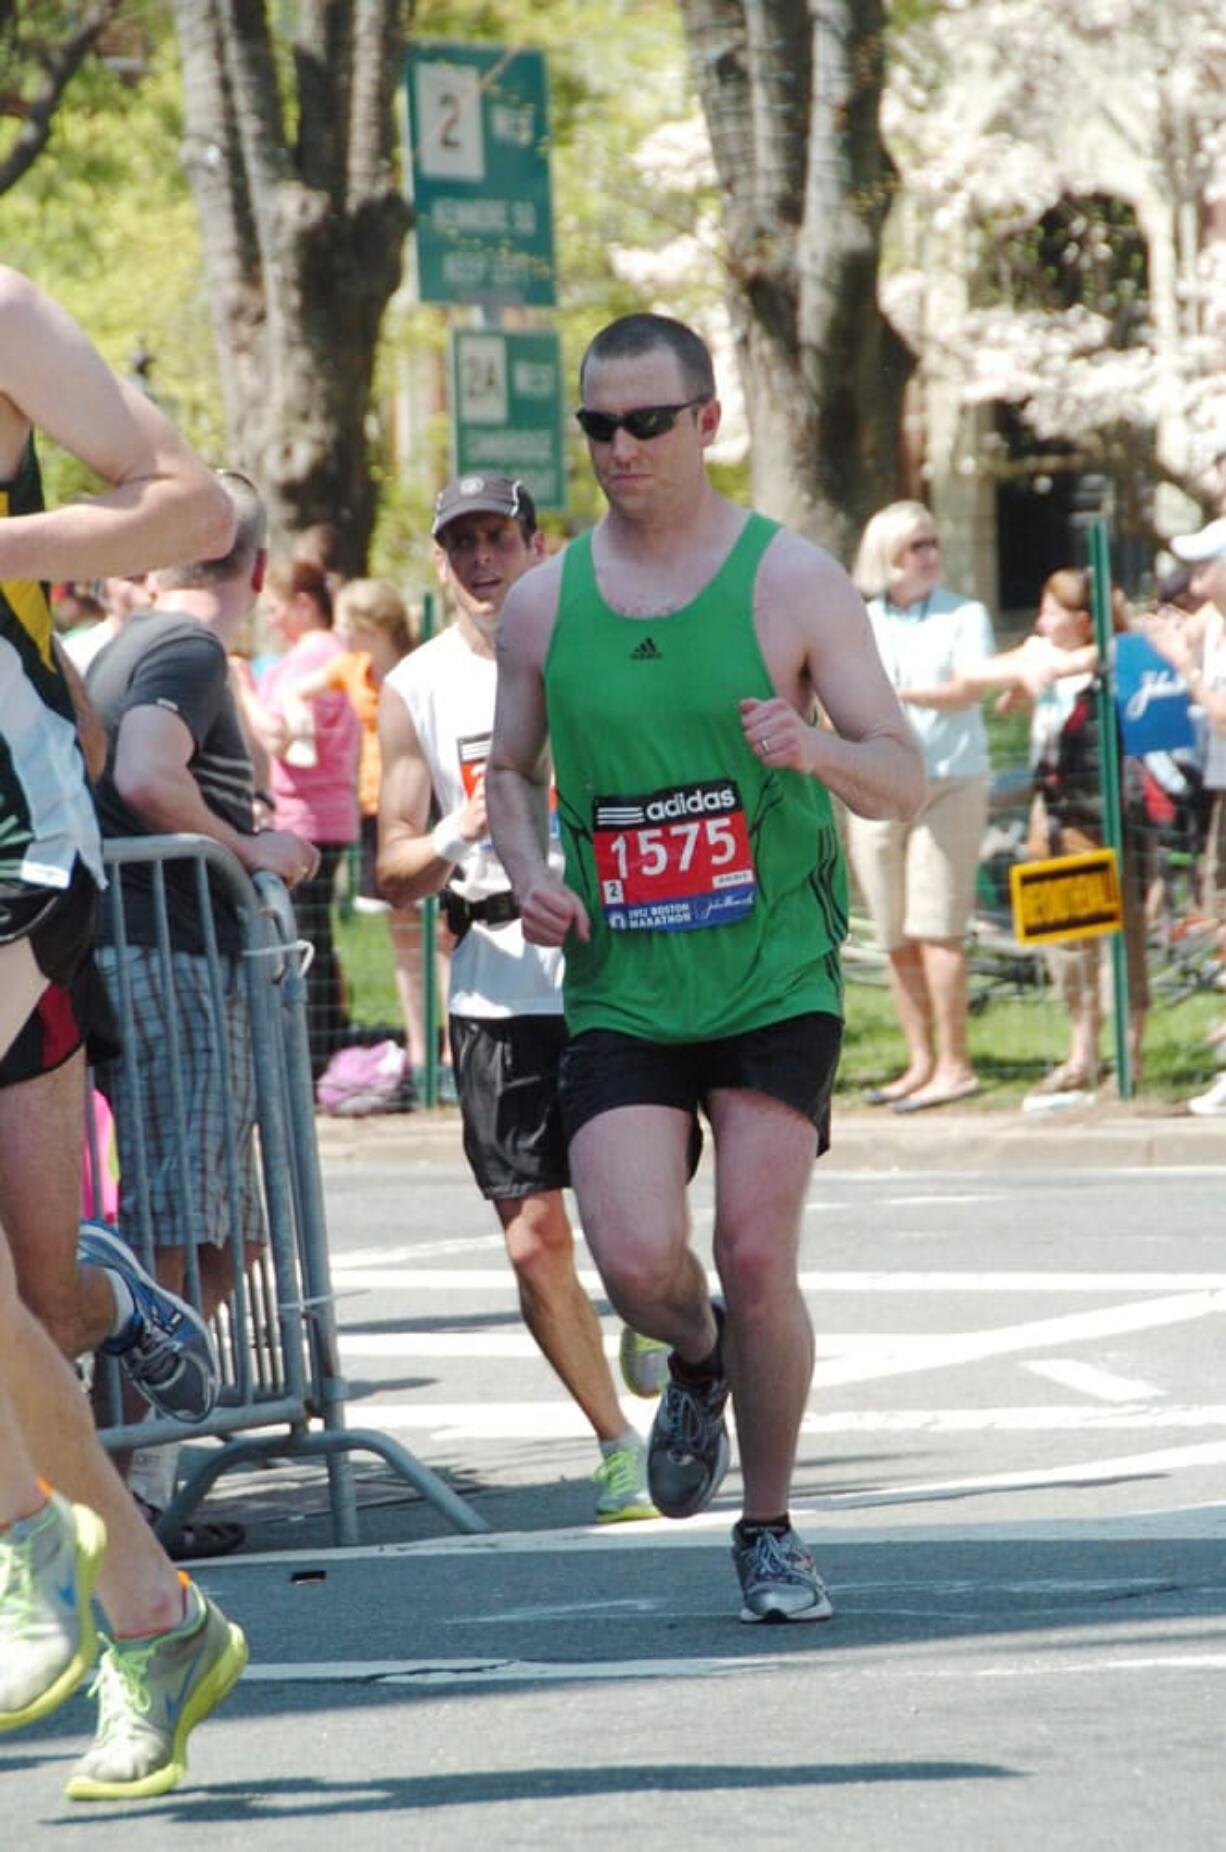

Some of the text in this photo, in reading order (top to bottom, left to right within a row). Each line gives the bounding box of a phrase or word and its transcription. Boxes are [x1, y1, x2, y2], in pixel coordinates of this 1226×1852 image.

[439, 93, 461, 149] 2
[646, 789, 736, 821] adidas
[610, 817, 737, 880] 1575
[608, 882, 619, 897] 2
